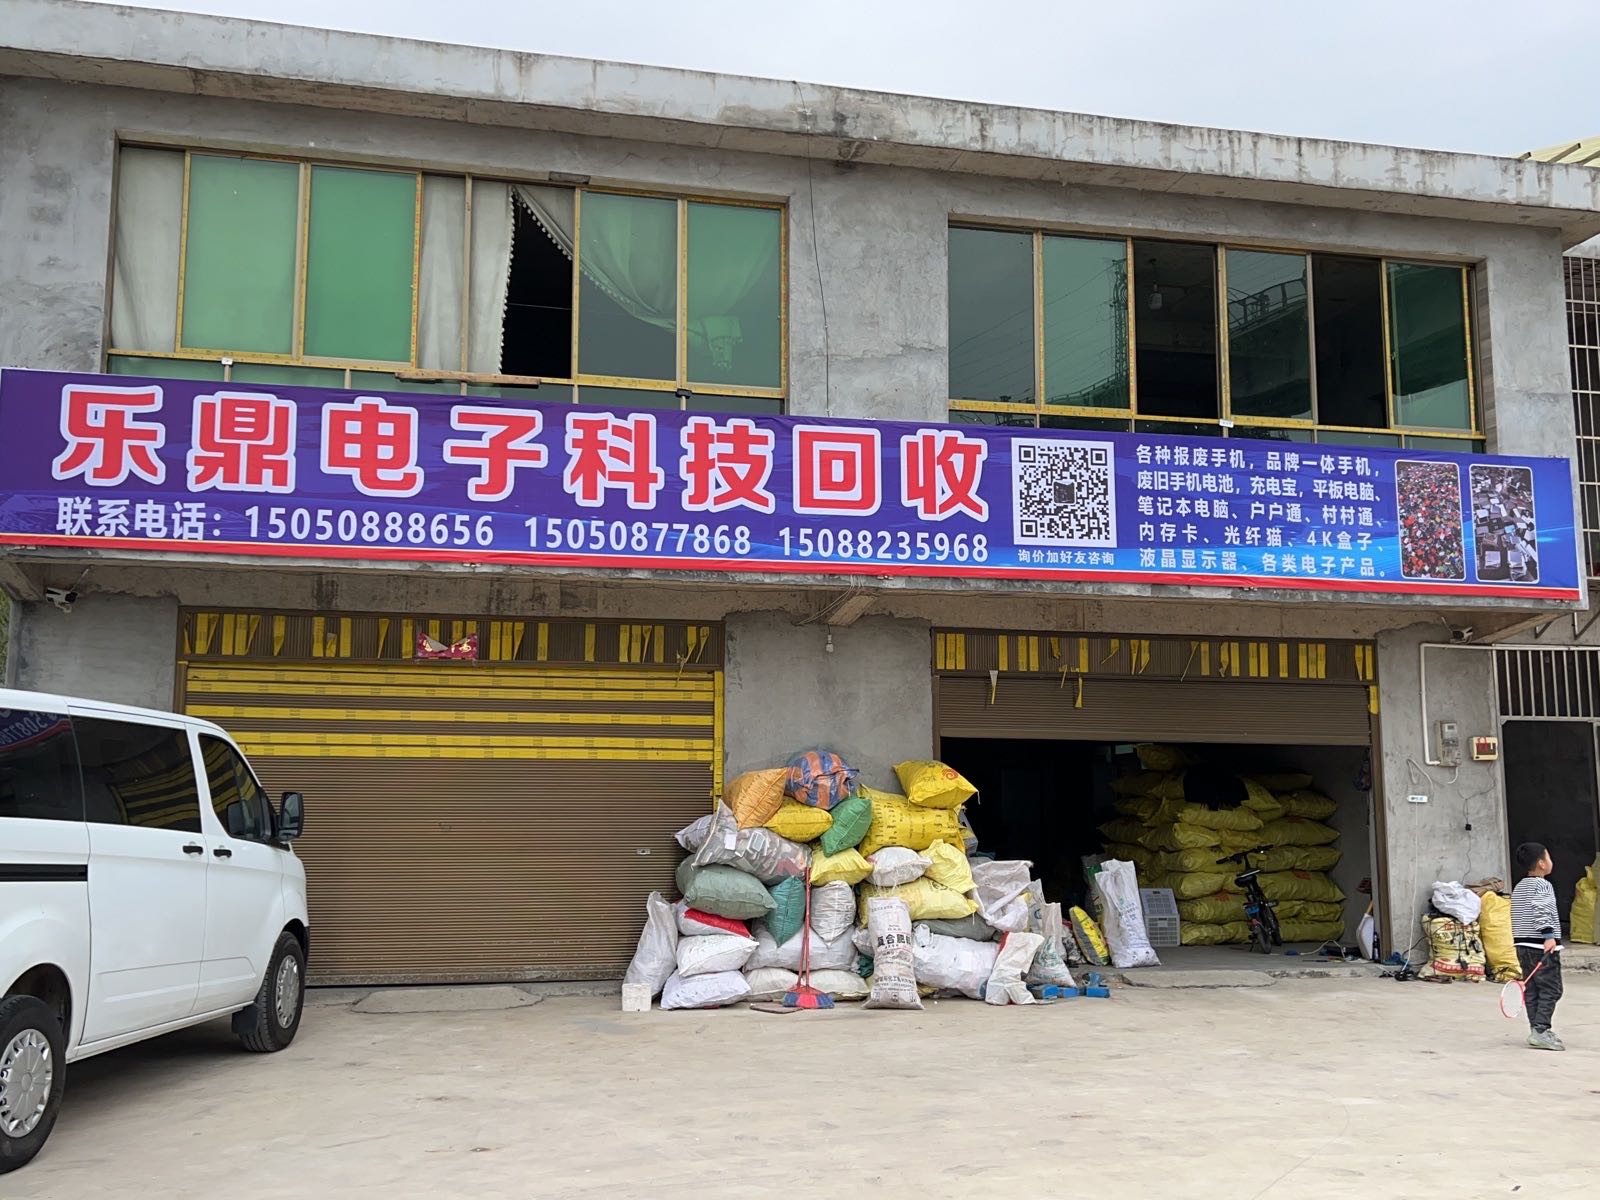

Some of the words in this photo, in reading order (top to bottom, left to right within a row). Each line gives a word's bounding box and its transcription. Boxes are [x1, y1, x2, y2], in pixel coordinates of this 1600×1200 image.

[52, 384, 988, 522] 乐鼎电子科技回收
[246, 506, 494, 546] 15050888656
[525, 517, 751, 555] 15050877868
[779, 527, 988, 563] 15088235968
[1018, 549, 1114, 565] 询价加好友咨询
